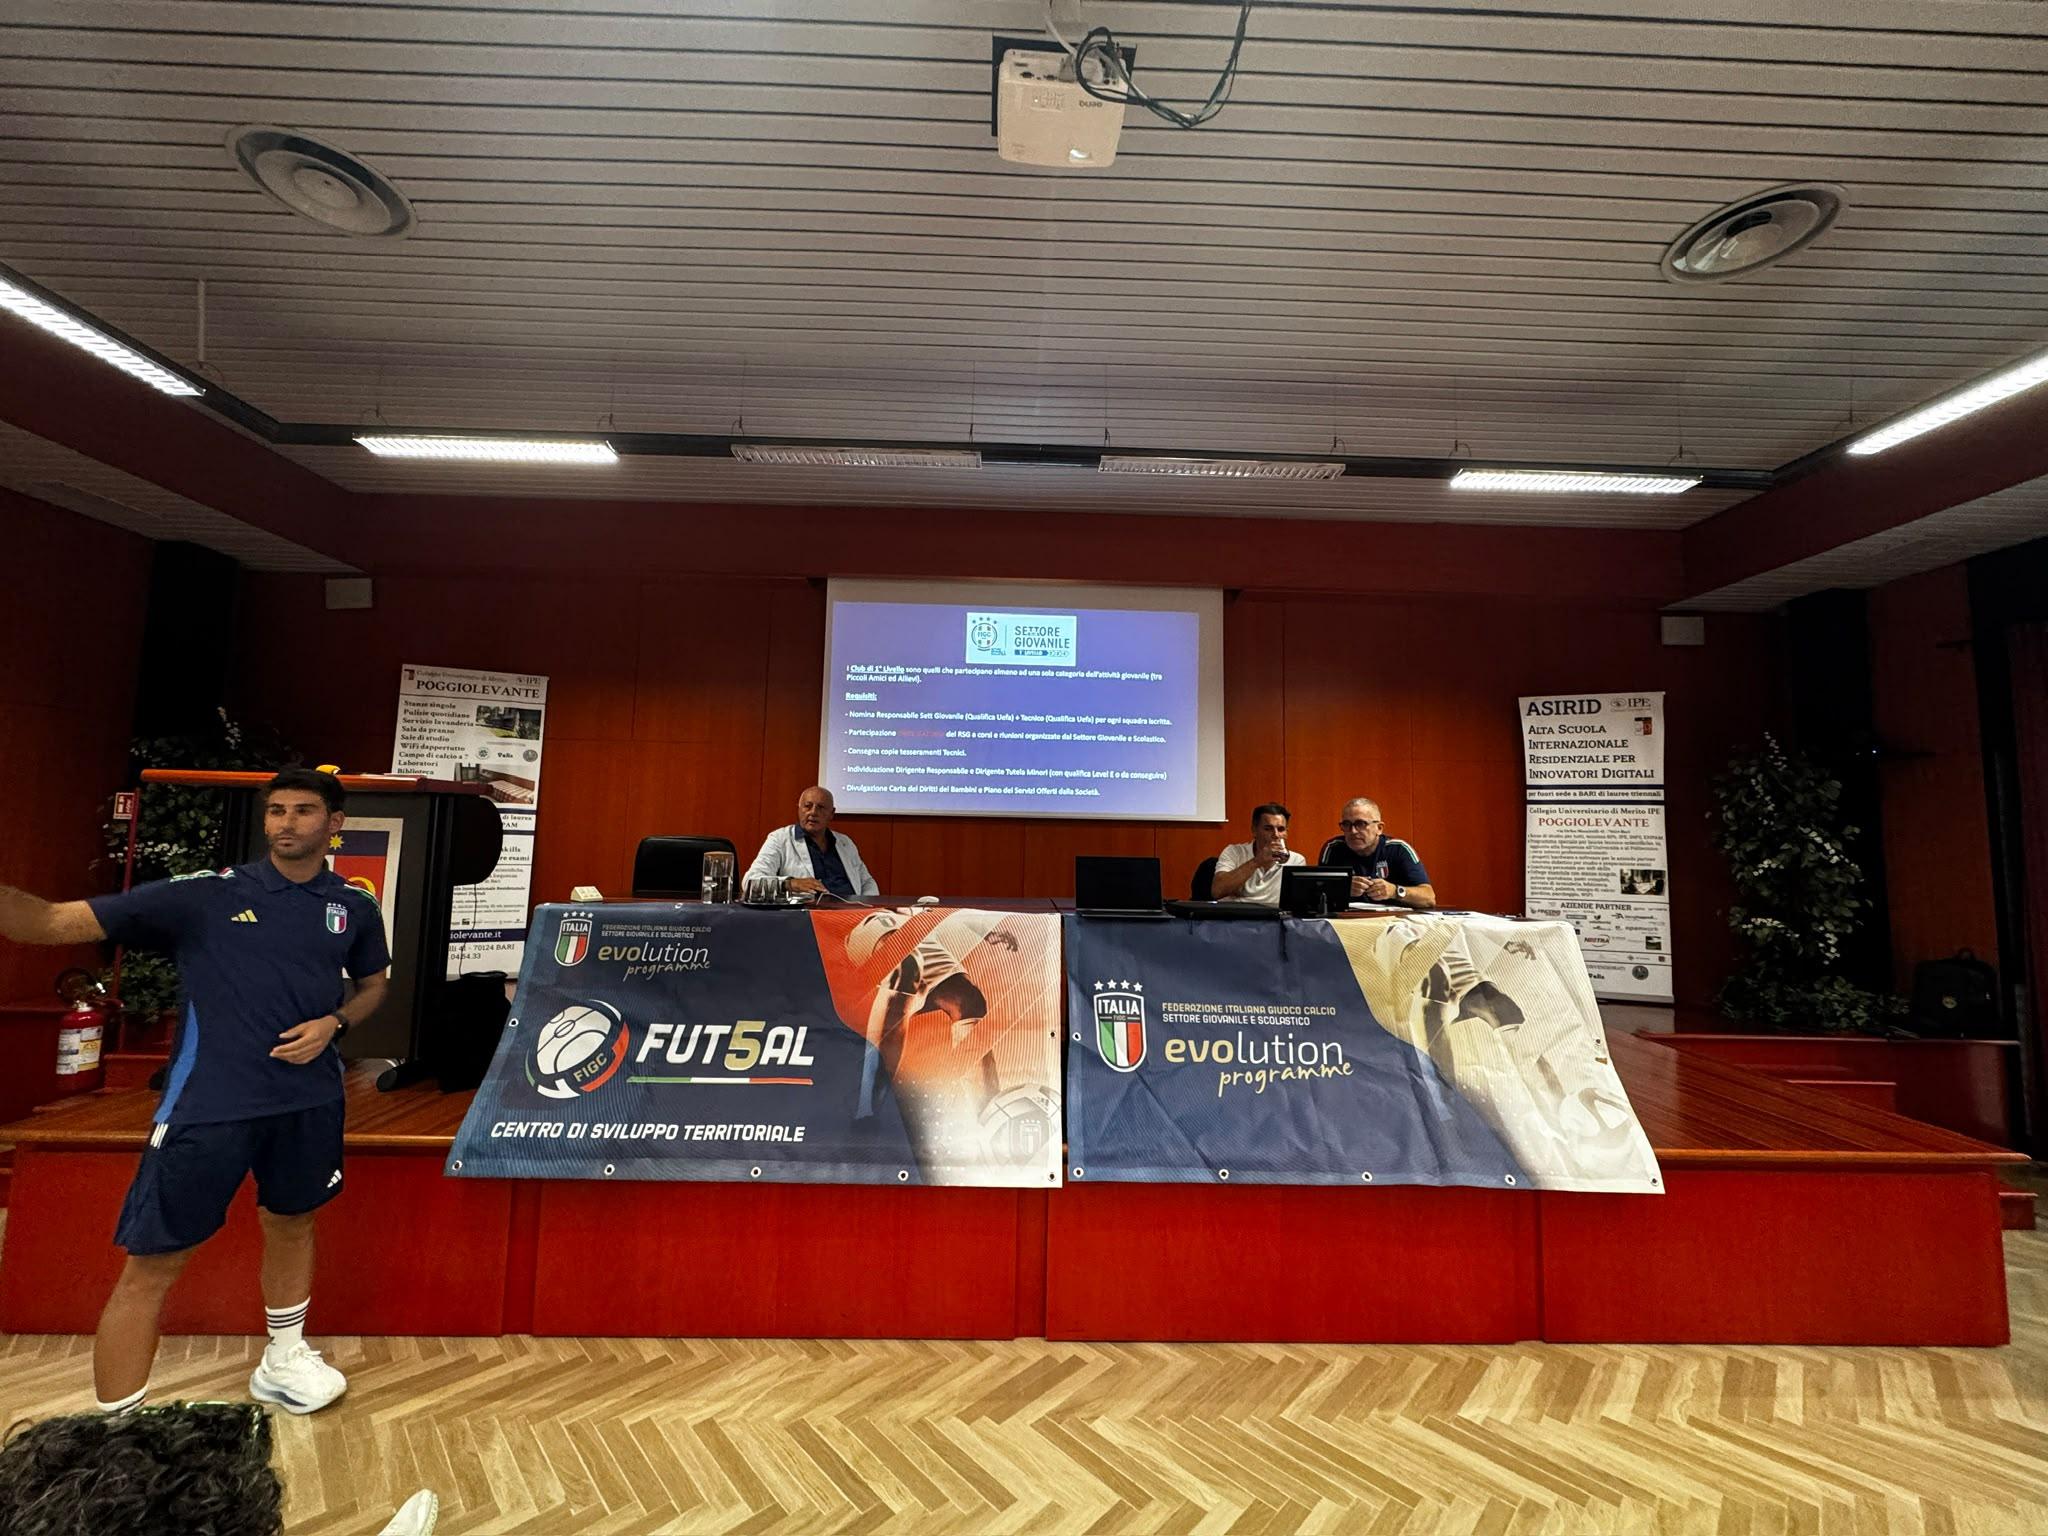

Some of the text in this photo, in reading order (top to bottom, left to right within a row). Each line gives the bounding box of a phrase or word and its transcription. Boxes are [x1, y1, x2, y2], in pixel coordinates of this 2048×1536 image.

[1015, 626, 1060, 637] SETTORE
[1014, 637, 1070, 648] GIOVANILE
[851, 665, 865, 673] Club
[883, 666, 904, 674] Livello
[416, 680, 540, 698] POGGIOLEVANTE
[1526, 699, 1602, 716] ASIRID
[1628, 698, 1651, 707] IPE
[434, 719, 474, 727] lavanderia
[428, 728, 455, 736] pranzo
[1528, 724, 1607, 734] ALTA SCUOLA
[421, 743, 465, 753] dappertutto
[1529, 739, 1629, 750] INTERNAZIONALE
[399, 752, 424, 760] Campo
[848, 748, 879, 756] Consegna
[1529, 754, 1636, 764] RESIDENZIALE PER
[896, 766, 925, 774] Dirigente
[927, 767, 968, 775] Responsabile
[975, 768, 1004, 776] Dirigente
[1130, 772, 1167, 780] conseguire)
[1529, 768, 1654, 779] INNOVATORI DIGITALI
[1538, 817, 1650, 827] POGGIOLEVANTE
[562, 922, 588, 932] ITALIA
[450, 930, 501, 940] iolevante.it
[598, 941, 709, 963] evolution
[622, 961, 711, 982] programme
[1098, 1000, 1140, 1015] ITALIA
[1162, 1002, 1336, 1016] FEDERAZIONE ITALIANA GIUOCO CALCIO
[1162, 1014, 1310, 1026] SETTORE GIOVANILE E SCOLASTICO
[635, 1020, 814, 1072] FUT5AL
[1164, 1031, 1344, 1066] evolution
[573, 1052, 608, 1083] FIGC
[1218, 1060, 1354, 1098] programme
[490, 1122, 805, 1143] CENTRO DI SVILUPPO TERRITORIALE
